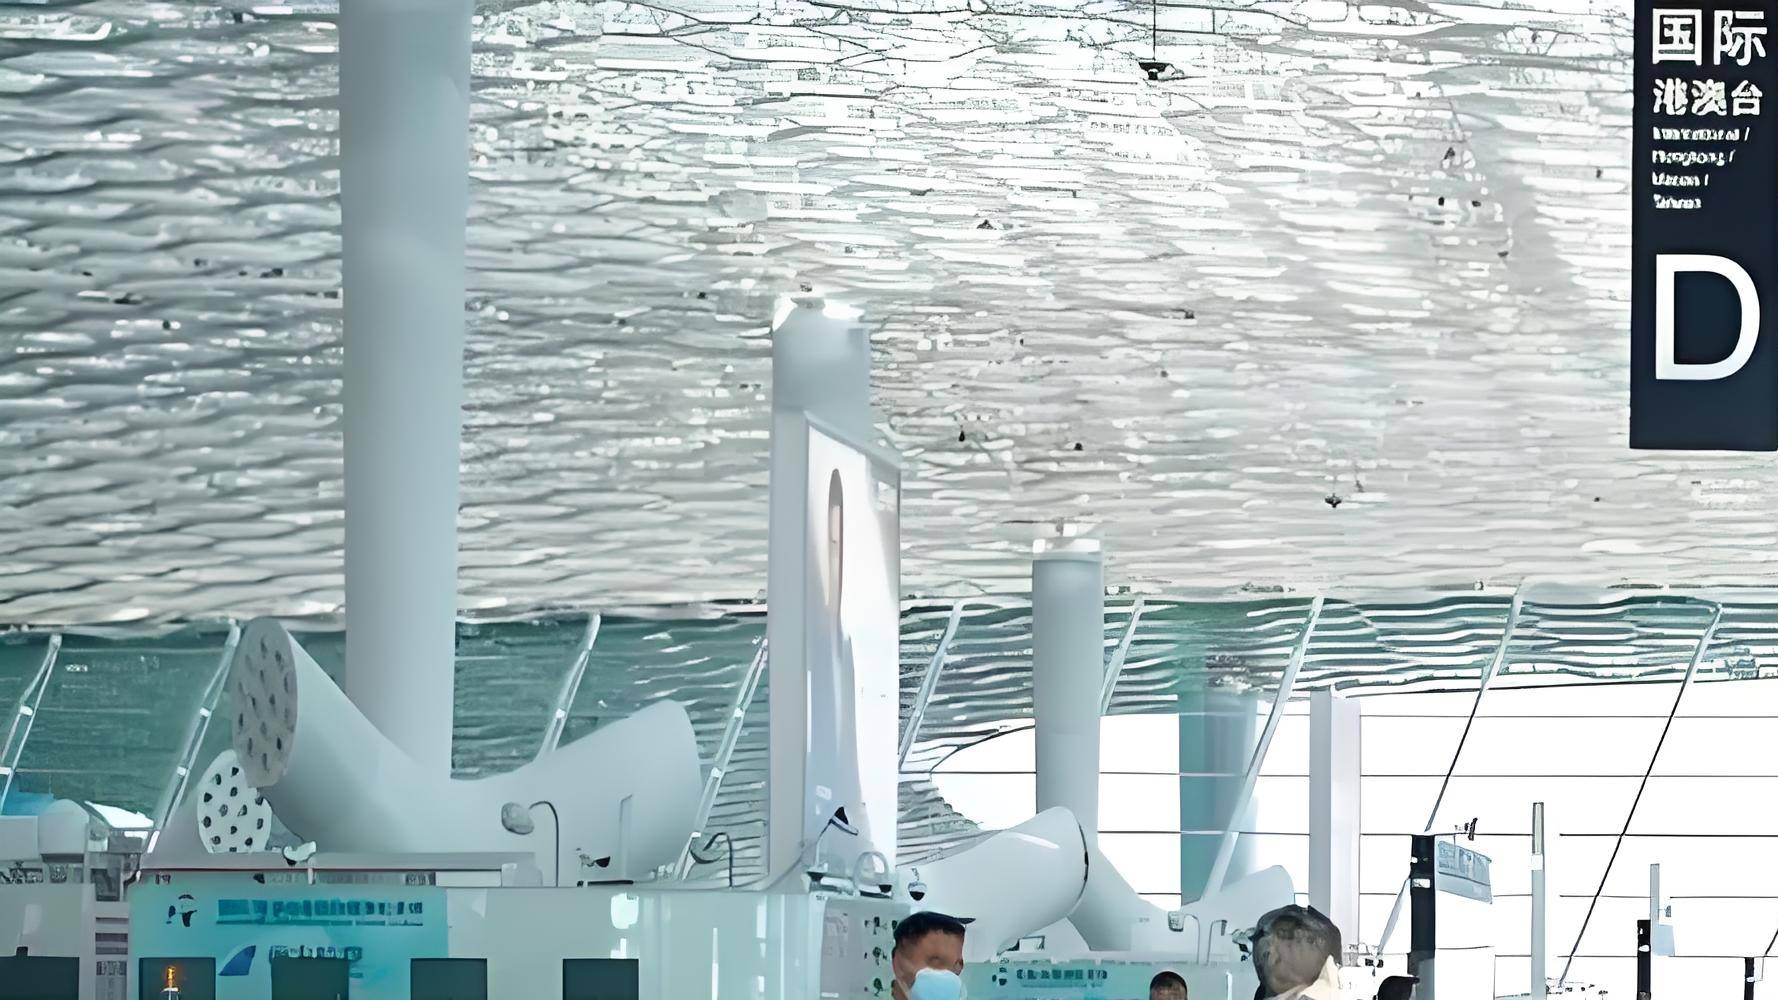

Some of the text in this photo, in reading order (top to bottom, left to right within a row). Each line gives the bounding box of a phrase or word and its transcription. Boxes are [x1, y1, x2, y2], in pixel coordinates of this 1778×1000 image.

[1652, 8, 1768, 66] 国际
[1652, 77, 1763, 116] 港澳台
[1655, 253, 1761, 381] D
